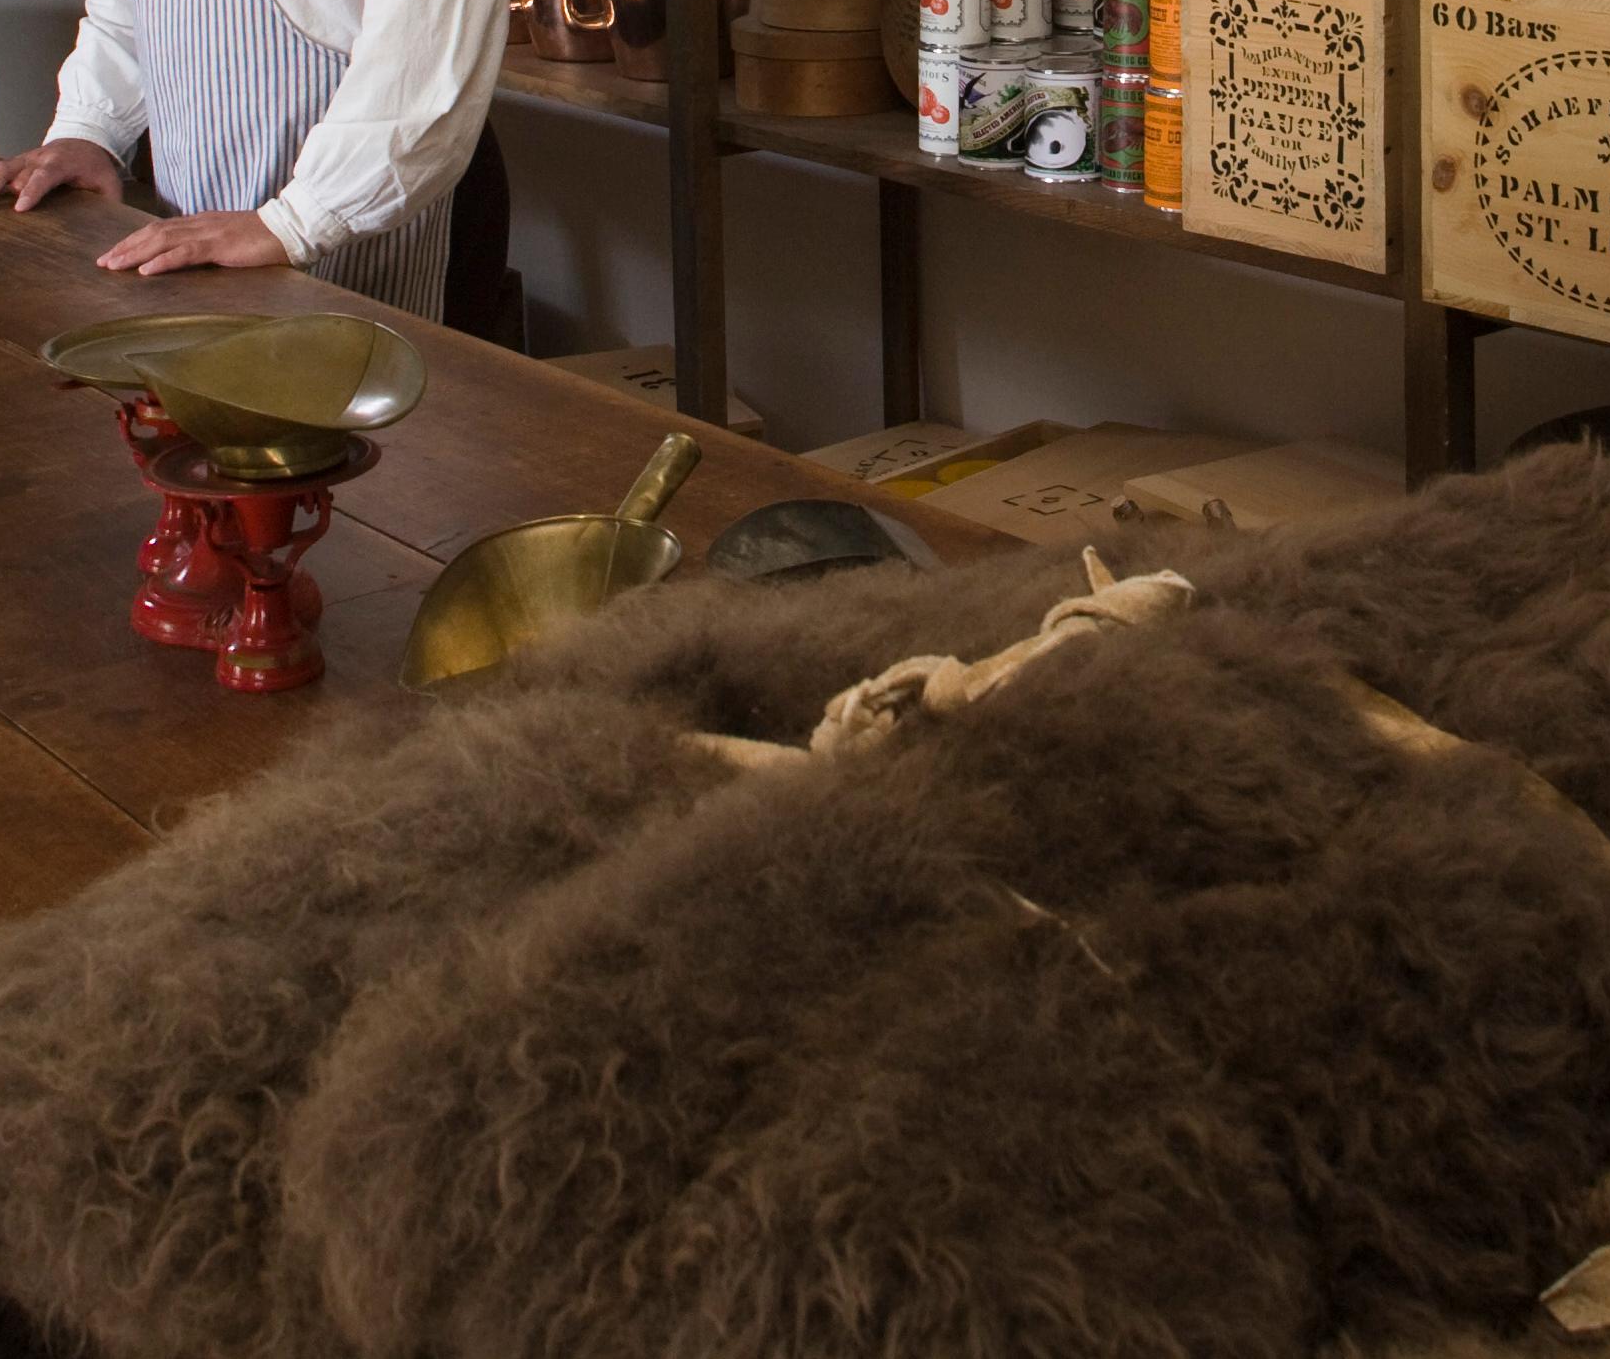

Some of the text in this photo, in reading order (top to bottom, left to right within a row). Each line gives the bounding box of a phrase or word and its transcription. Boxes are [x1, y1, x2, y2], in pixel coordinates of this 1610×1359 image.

[1241, 46, 1334, 75] WARRANTED
[1262, 66, 1312, 84] EXTRA
[1241, 78, 1332, 112] PEPPER
[973, 116, 1000, 139] SELECTED
[1241, 106, 1333, 142] SAUCE
[1242, 132, 1331, 176] Family Use
[1271, 136, 1302, 151] FOR
[1499, 174, 1600, 213] PALM
[1515, 212, 1570, 246] ST.
